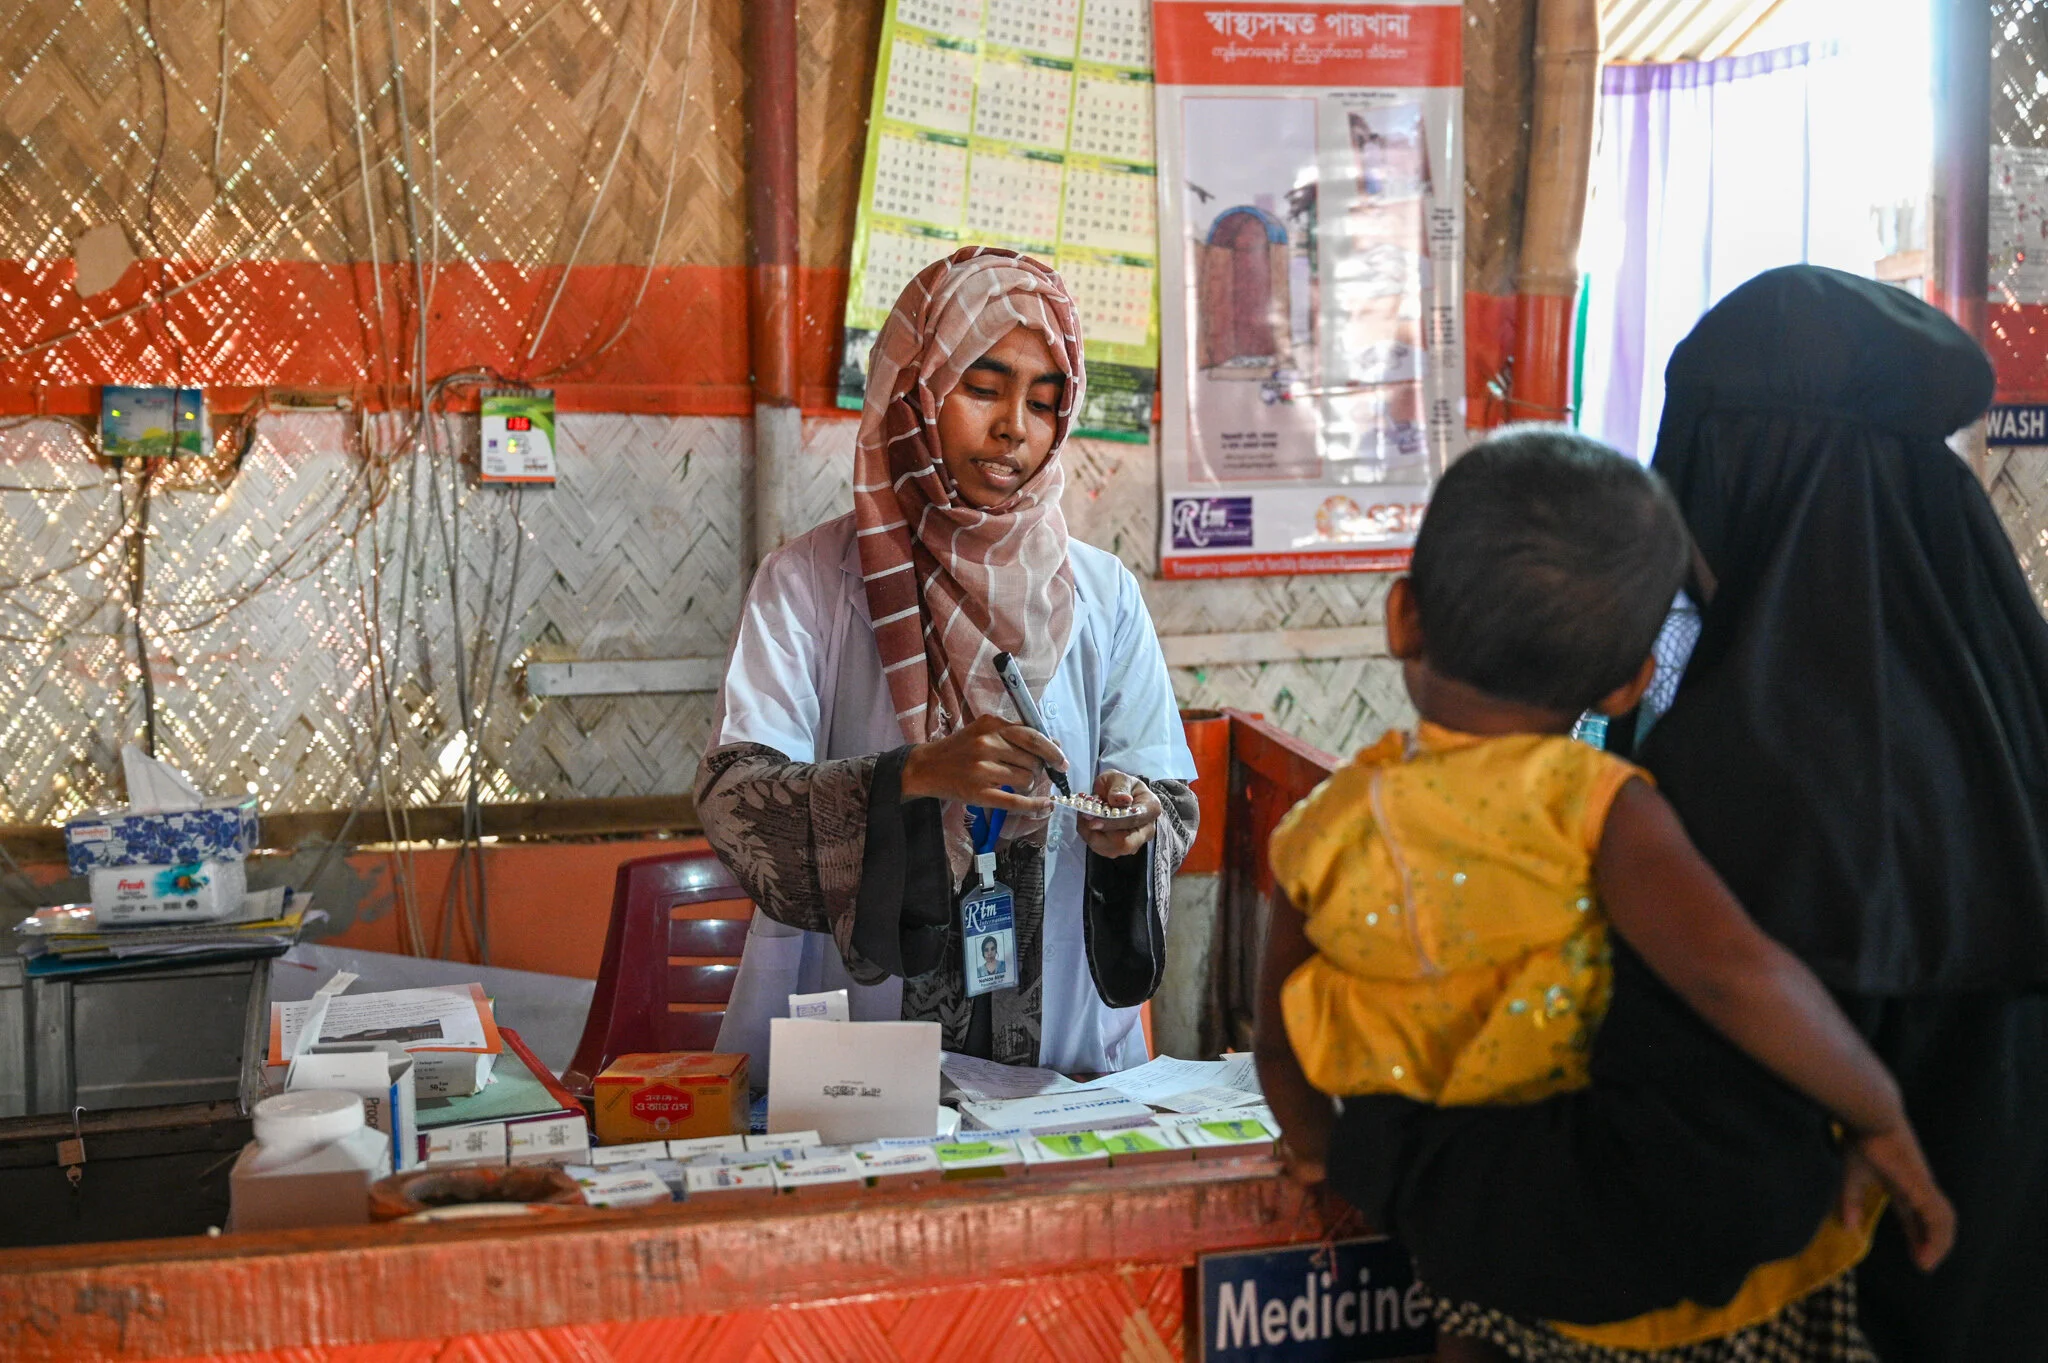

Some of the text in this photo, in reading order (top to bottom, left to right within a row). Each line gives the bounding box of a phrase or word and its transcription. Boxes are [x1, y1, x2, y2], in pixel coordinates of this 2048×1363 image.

[1203, 9, 1411, 41] স্বাস্থ্যসম্মত পায়খানা
[1987, 410, 2044, 438] WASH
[117, 879, 145, 891] Fresh
[964, 900, 998, 932] Rtm
[1216, 1266, 1429, 1350] Medicine
